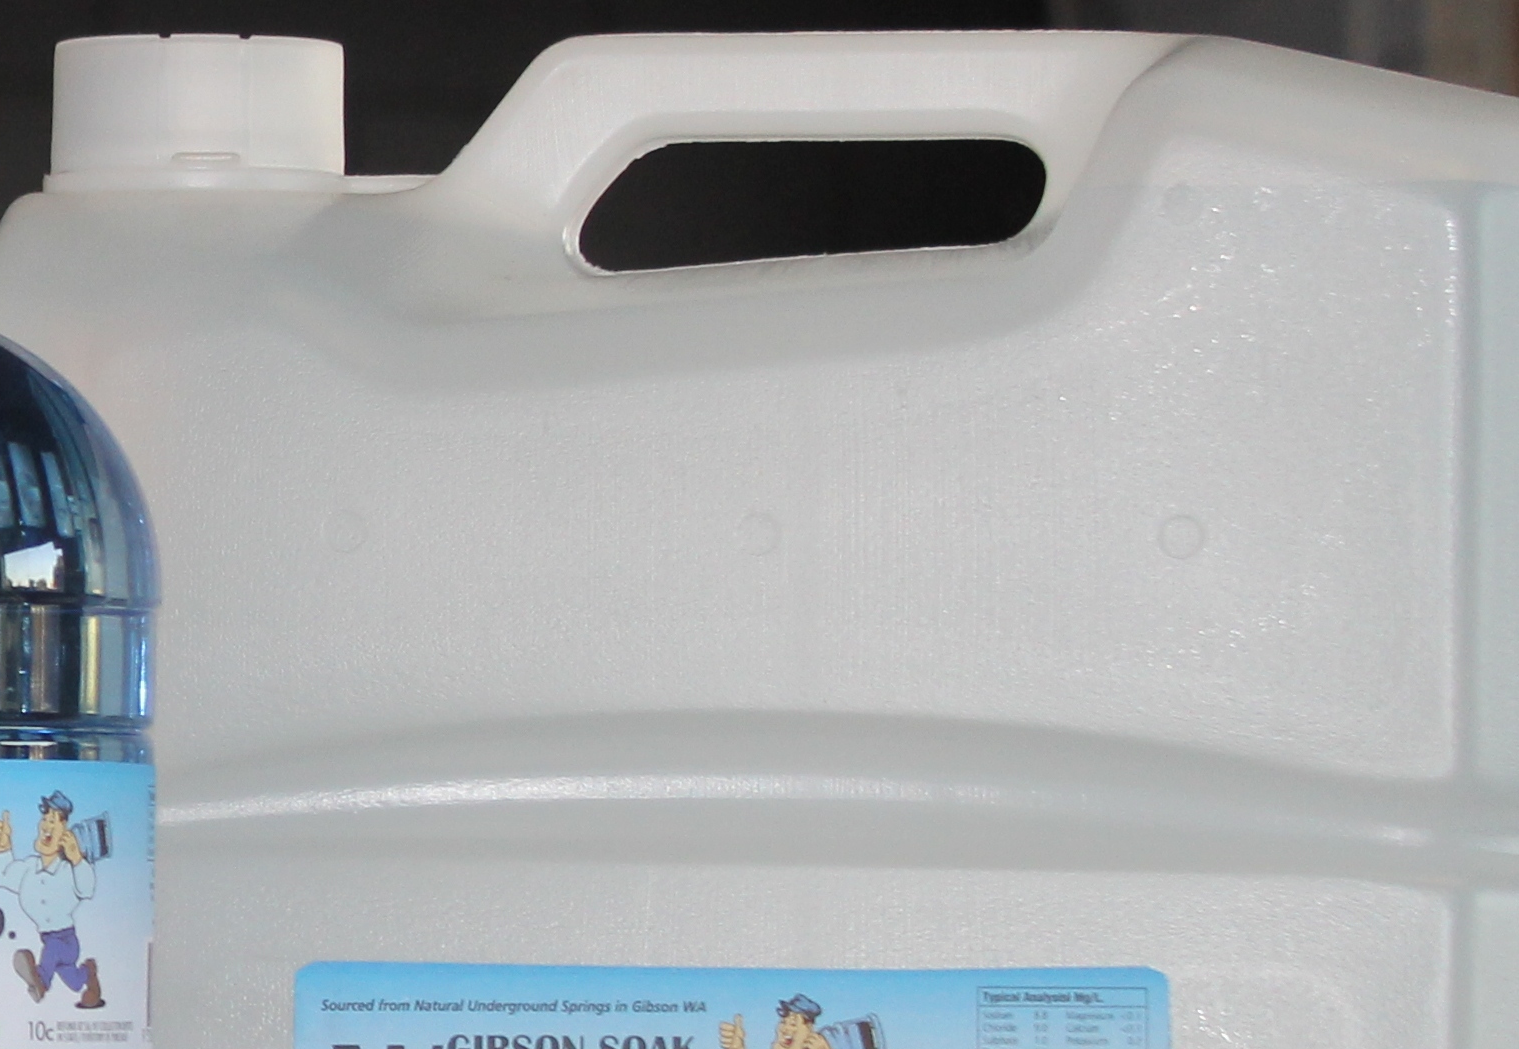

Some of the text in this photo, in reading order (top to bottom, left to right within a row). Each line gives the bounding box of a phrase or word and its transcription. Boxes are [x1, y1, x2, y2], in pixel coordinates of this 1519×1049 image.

[321, 999, 707, 1015] Sourced from Natural Underground Springs in Gibson WA
[28, 1020, 54, 1041] 10c
